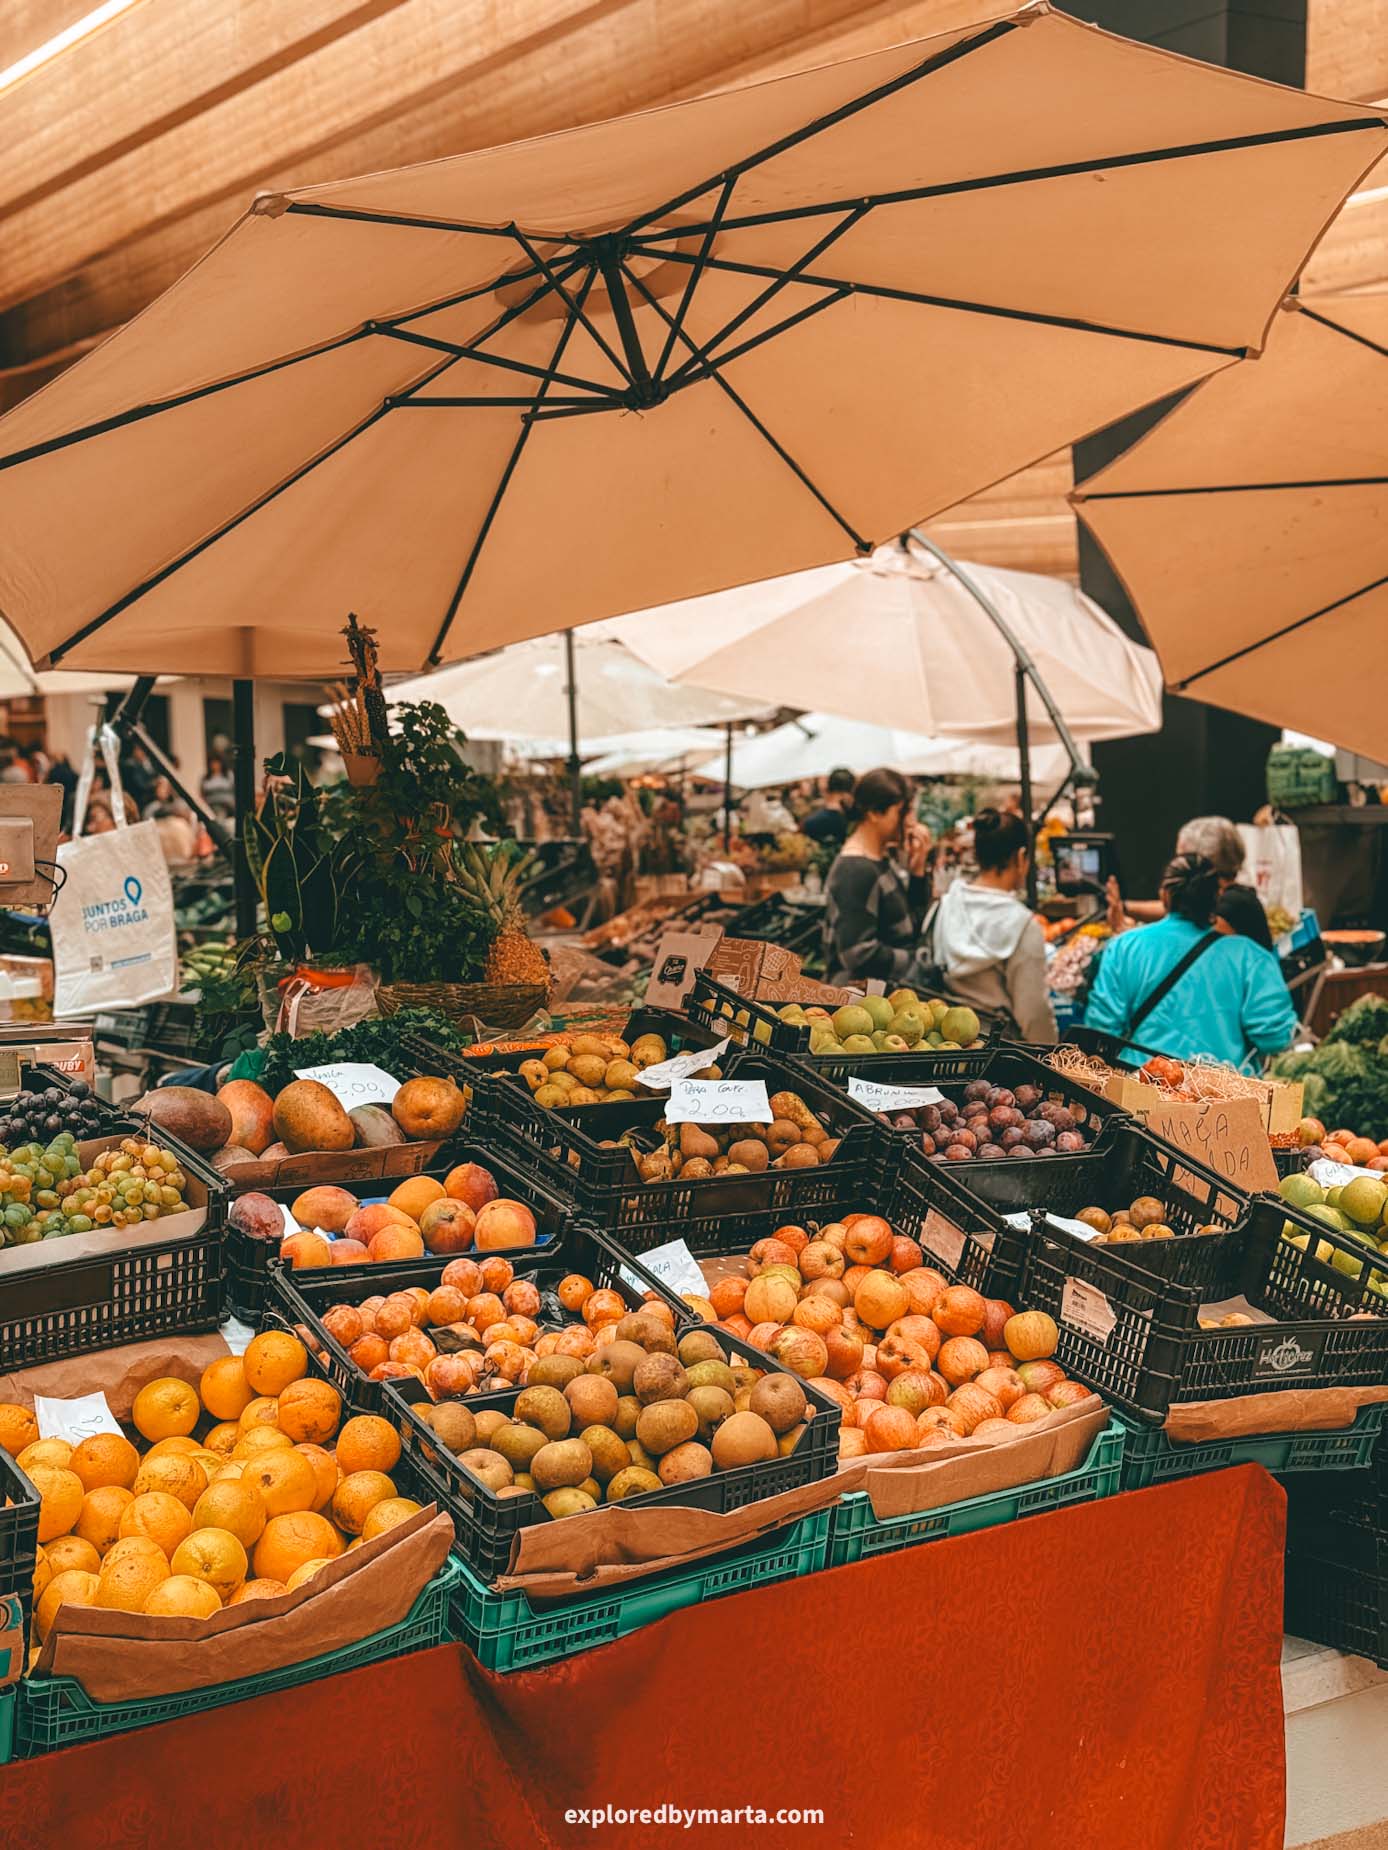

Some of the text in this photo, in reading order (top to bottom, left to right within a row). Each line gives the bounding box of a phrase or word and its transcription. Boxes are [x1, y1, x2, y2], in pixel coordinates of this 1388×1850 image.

[82, 899, 127, 919] JUNTOS
[84, 909, 148, 933] POR BRAGA
